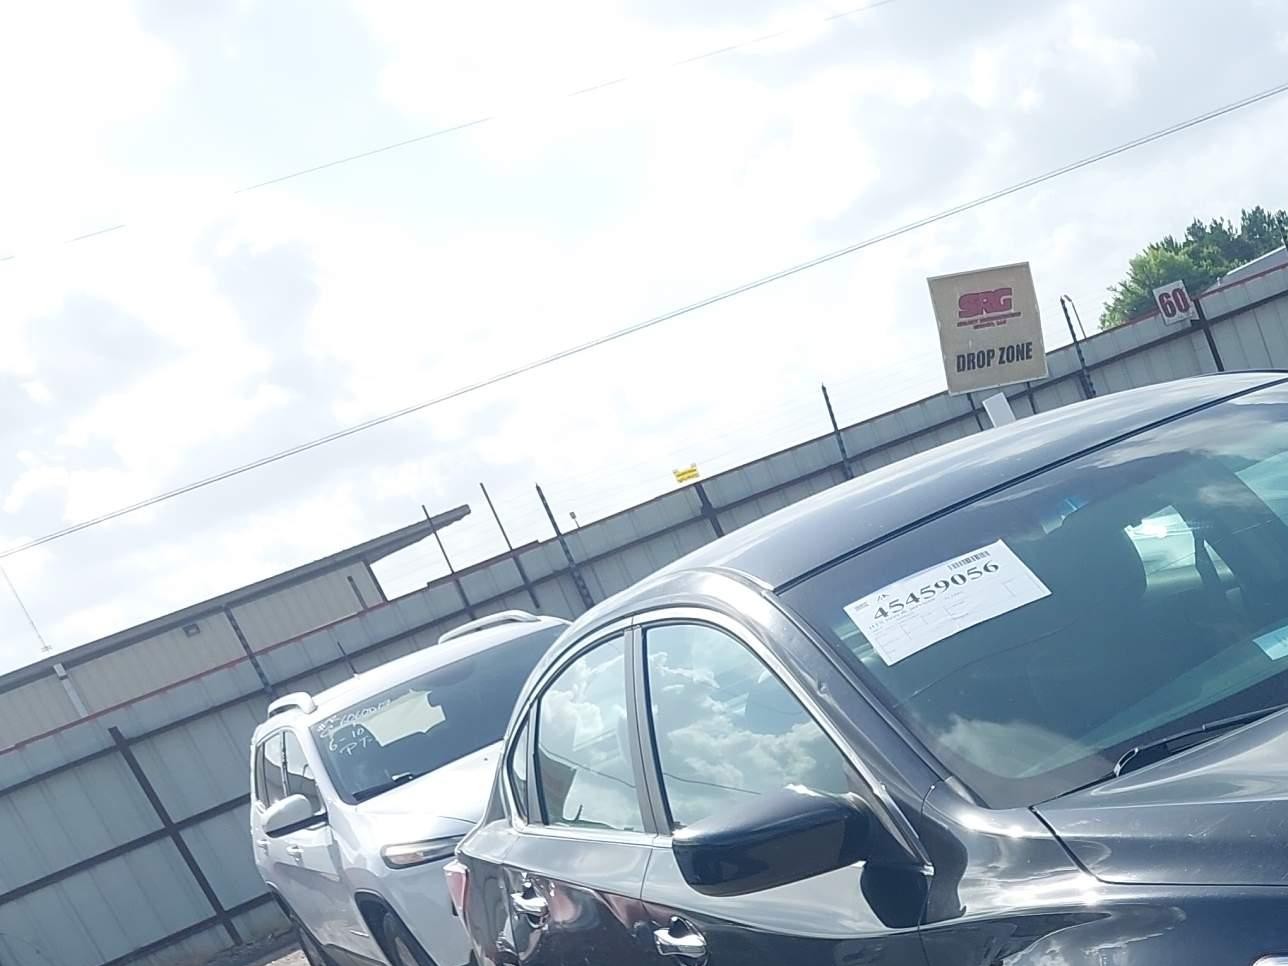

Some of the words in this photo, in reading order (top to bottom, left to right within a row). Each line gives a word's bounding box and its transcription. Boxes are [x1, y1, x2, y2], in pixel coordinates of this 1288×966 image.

[959, 288, 1012, 318] SRG
[1159, 288, 1190, 318] 60
[957, 349, 995, 373] DROP
[998, 341, 1033, 365] ZONE
[874, 560, 999, 620] 45459056
